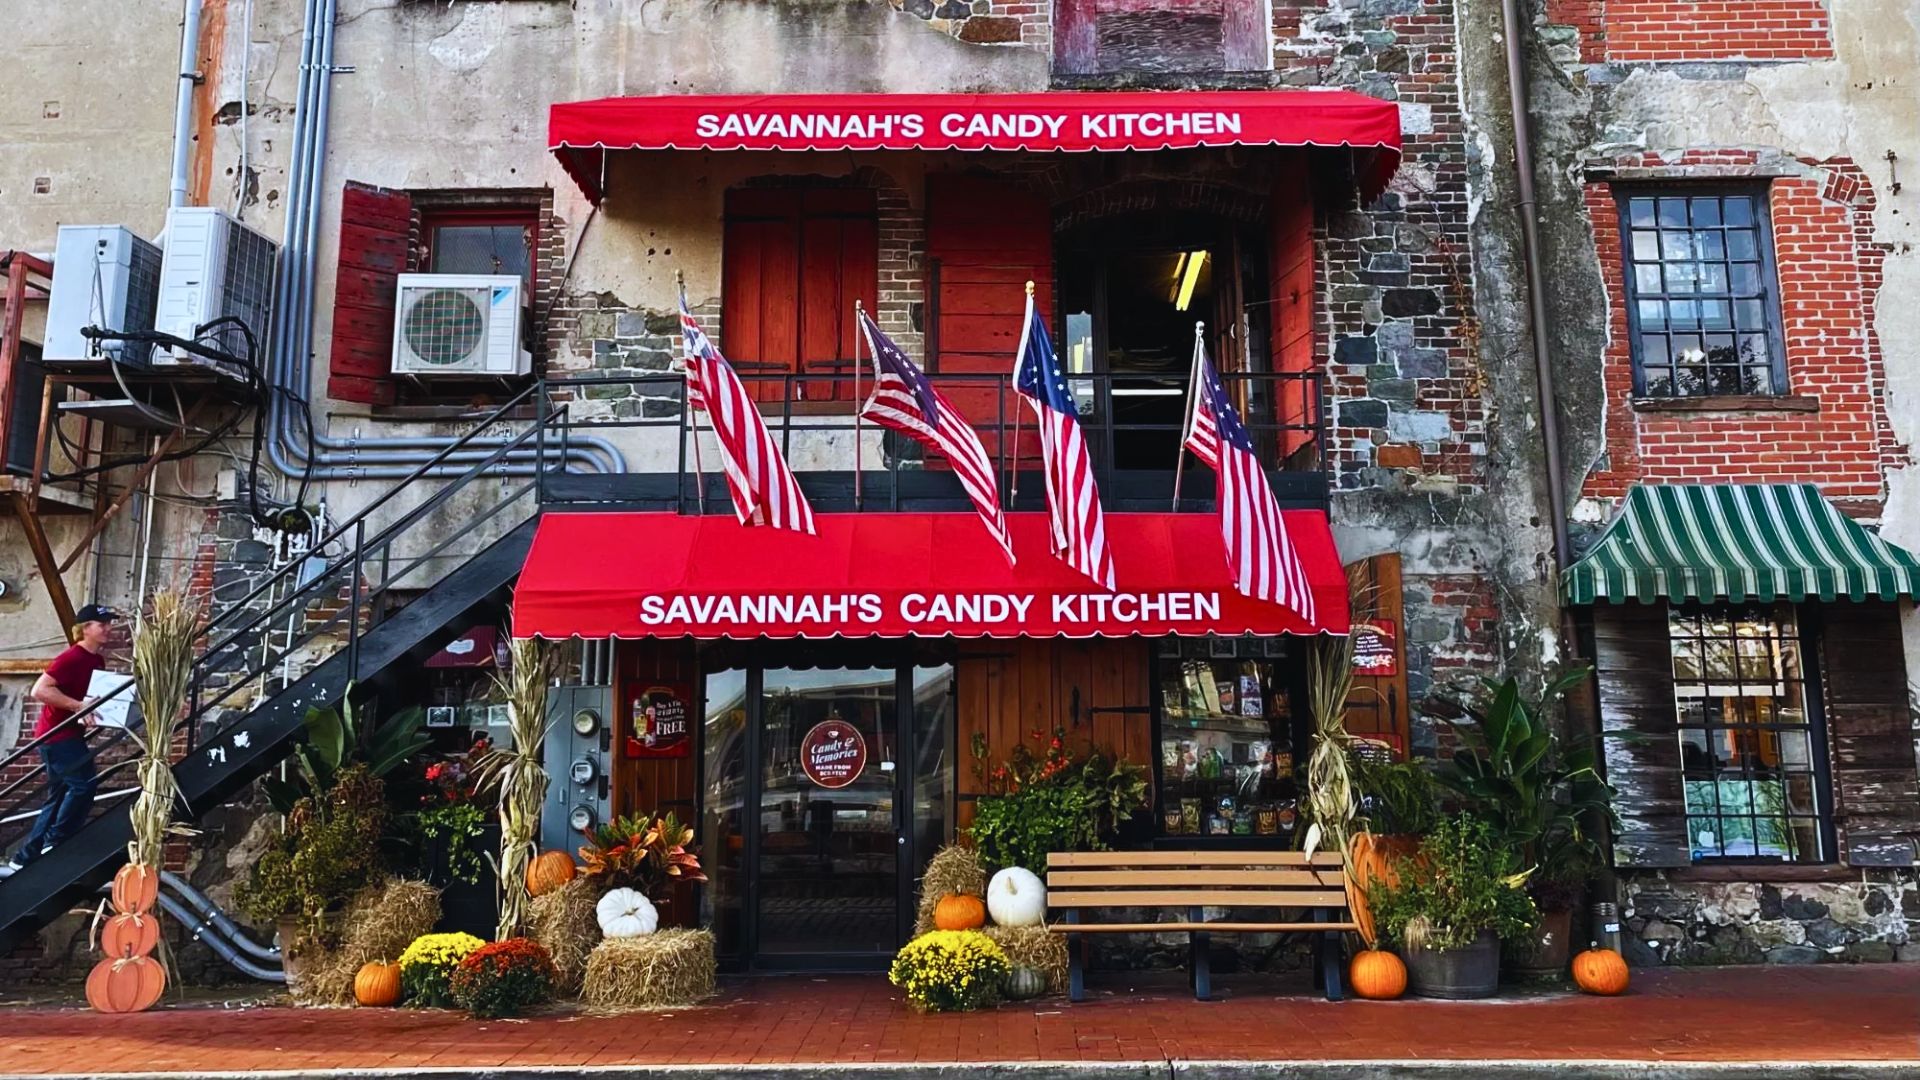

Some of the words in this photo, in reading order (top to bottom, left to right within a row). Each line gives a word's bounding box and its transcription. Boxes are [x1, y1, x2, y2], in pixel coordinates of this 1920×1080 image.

[695, 113, 924, 138] SAVANNAH'S
[940, 113, 1067, 137] CANDY
[1082, 112, 1243, 136] KITCHEN
[640, 594, 883, 624] SAVANNAH'S
[900, 594, 1036, 622] CANDY
[1052, 592, 1221, 622] KITCHEN
[656, 721, 686, 735] FREE
[810, 740, 843, 754] Candy
[810, 748, 859, 765] Memories
